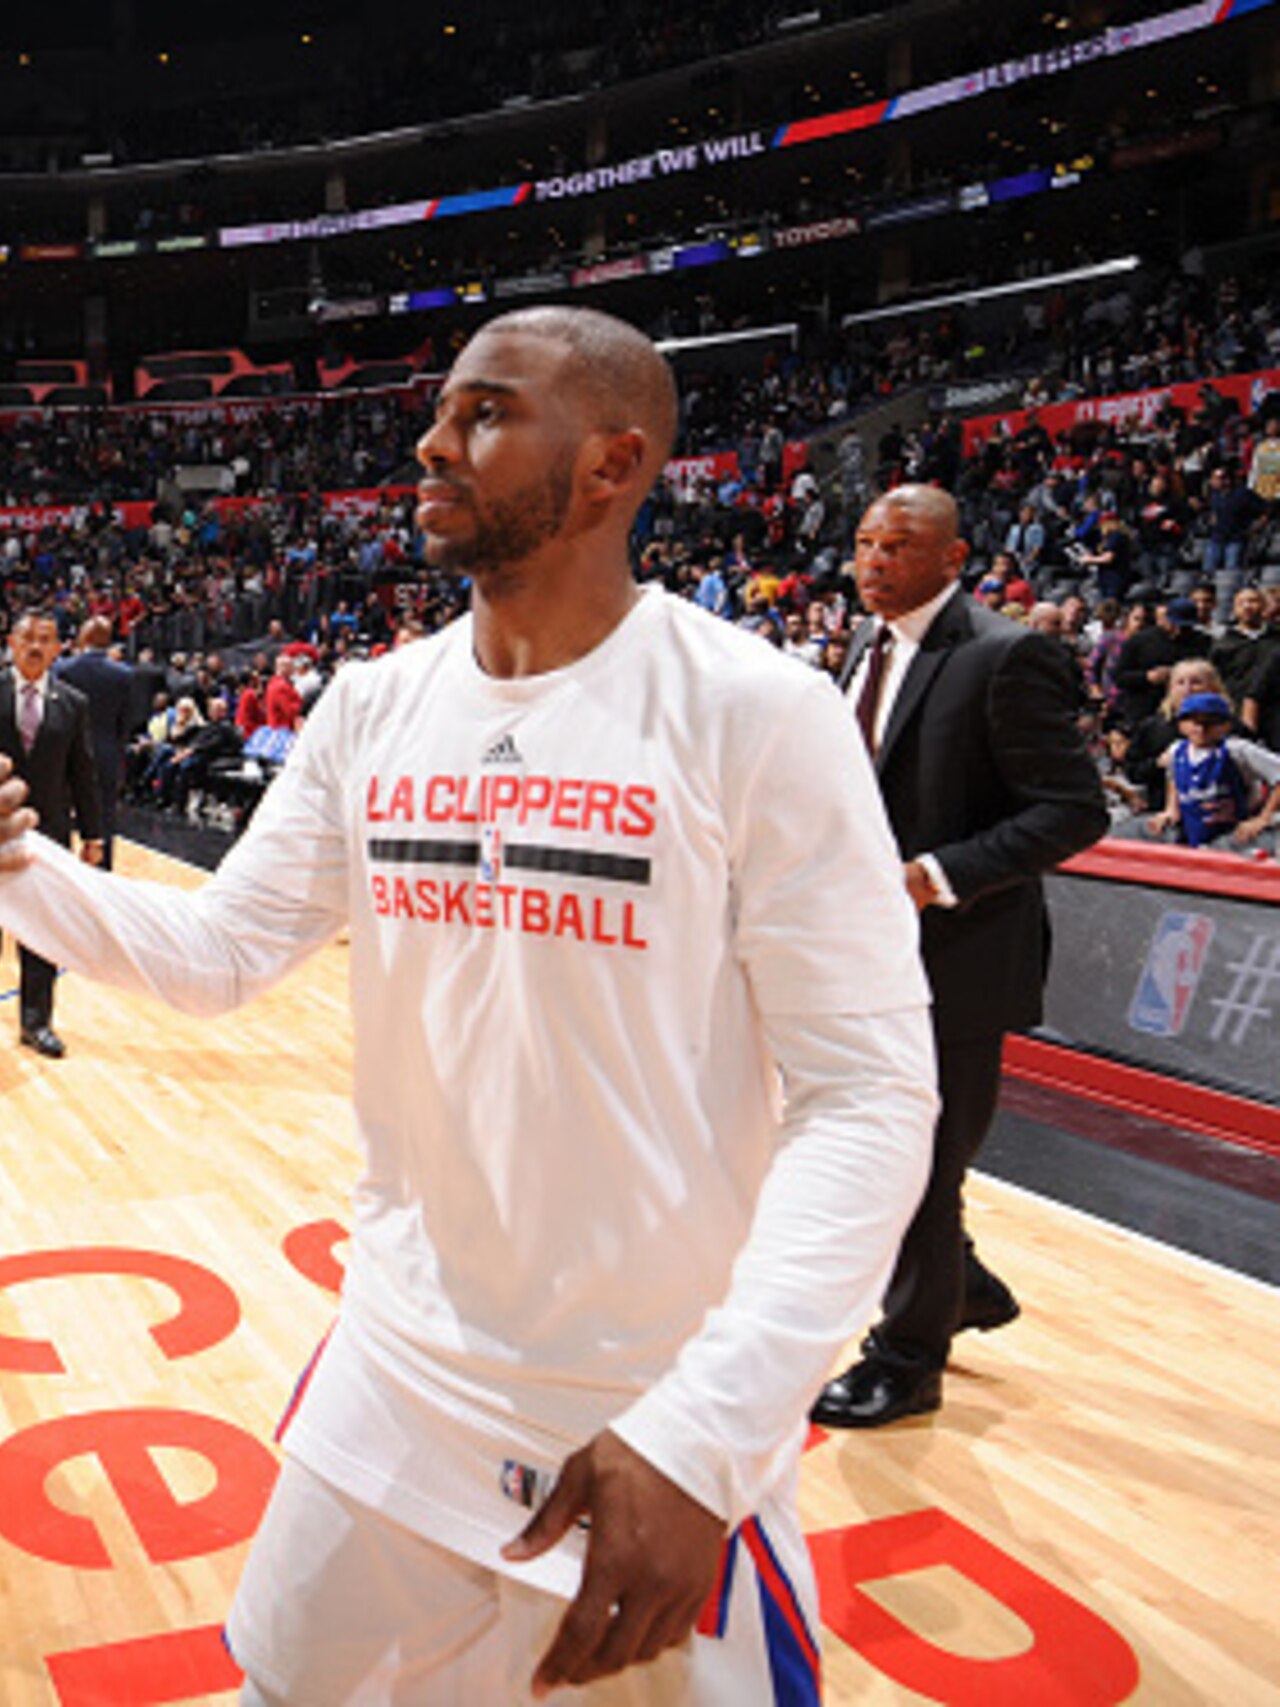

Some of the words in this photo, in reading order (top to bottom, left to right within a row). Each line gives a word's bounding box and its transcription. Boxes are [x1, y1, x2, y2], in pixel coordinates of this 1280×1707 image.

[535, 158, 653, 201] TOGETHER
[657, 147, 698, 174] WE
[704, 132, 764, 163] WILL
[774, 216, 860, 247] TOYOTA
[367, 776, 414, 822] LA
[425, 776, 656, 838] CLIPPERS
[372, 876, 648, 950] BASKETBALL
